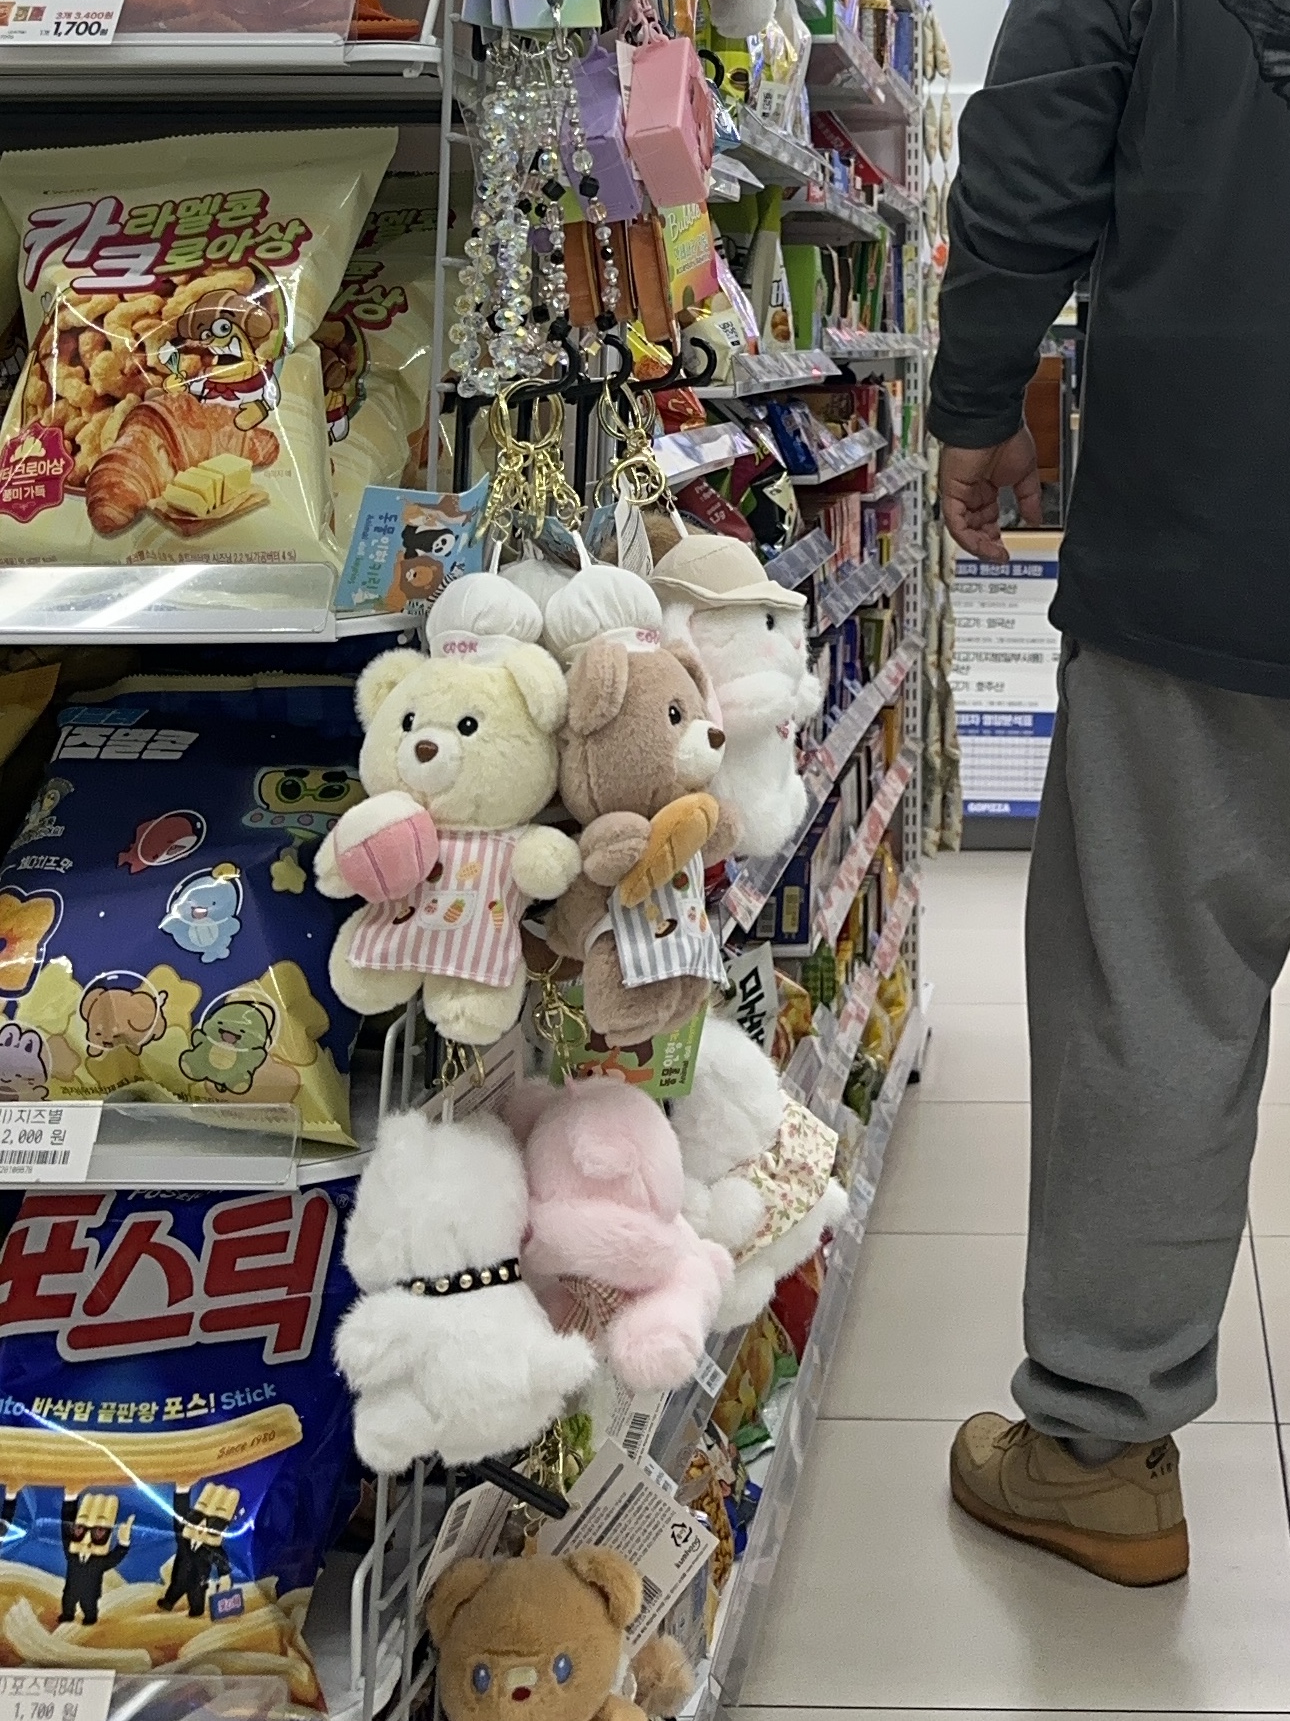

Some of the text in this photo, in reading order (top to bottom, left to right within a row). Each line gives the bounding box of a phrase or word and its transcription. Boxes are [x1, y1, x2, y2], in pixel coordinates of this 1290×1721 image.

[24, 486, 46, 500] 가득
[50, 1130, 66, 1146] 원
[0, 1188, 331, 1361] 포스틱
[32, 1381, 277, 1424] 바삭함 끝판왕 포스! Stick
[250, 1429, 277, 1450] 1980
